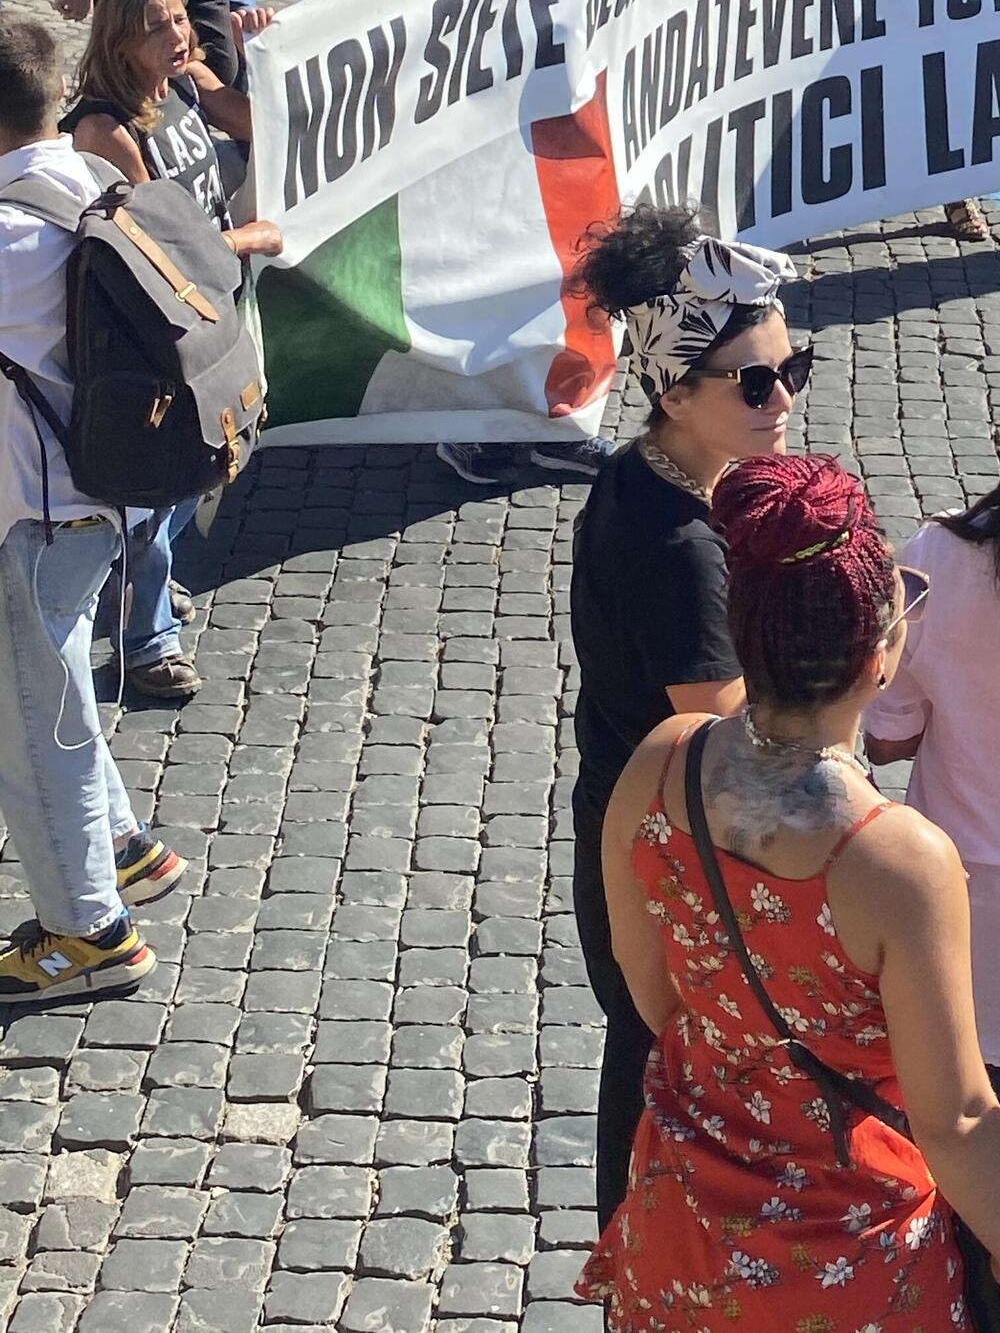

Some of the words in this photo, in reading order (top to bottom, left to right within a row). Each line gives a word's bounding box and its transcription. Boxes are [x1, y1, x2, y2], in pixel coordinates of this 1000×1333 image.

[146, 108, 213, 179] LAST
[284, 15, 407, 212] NON
[633, 65, 886, 240] OLITICI
